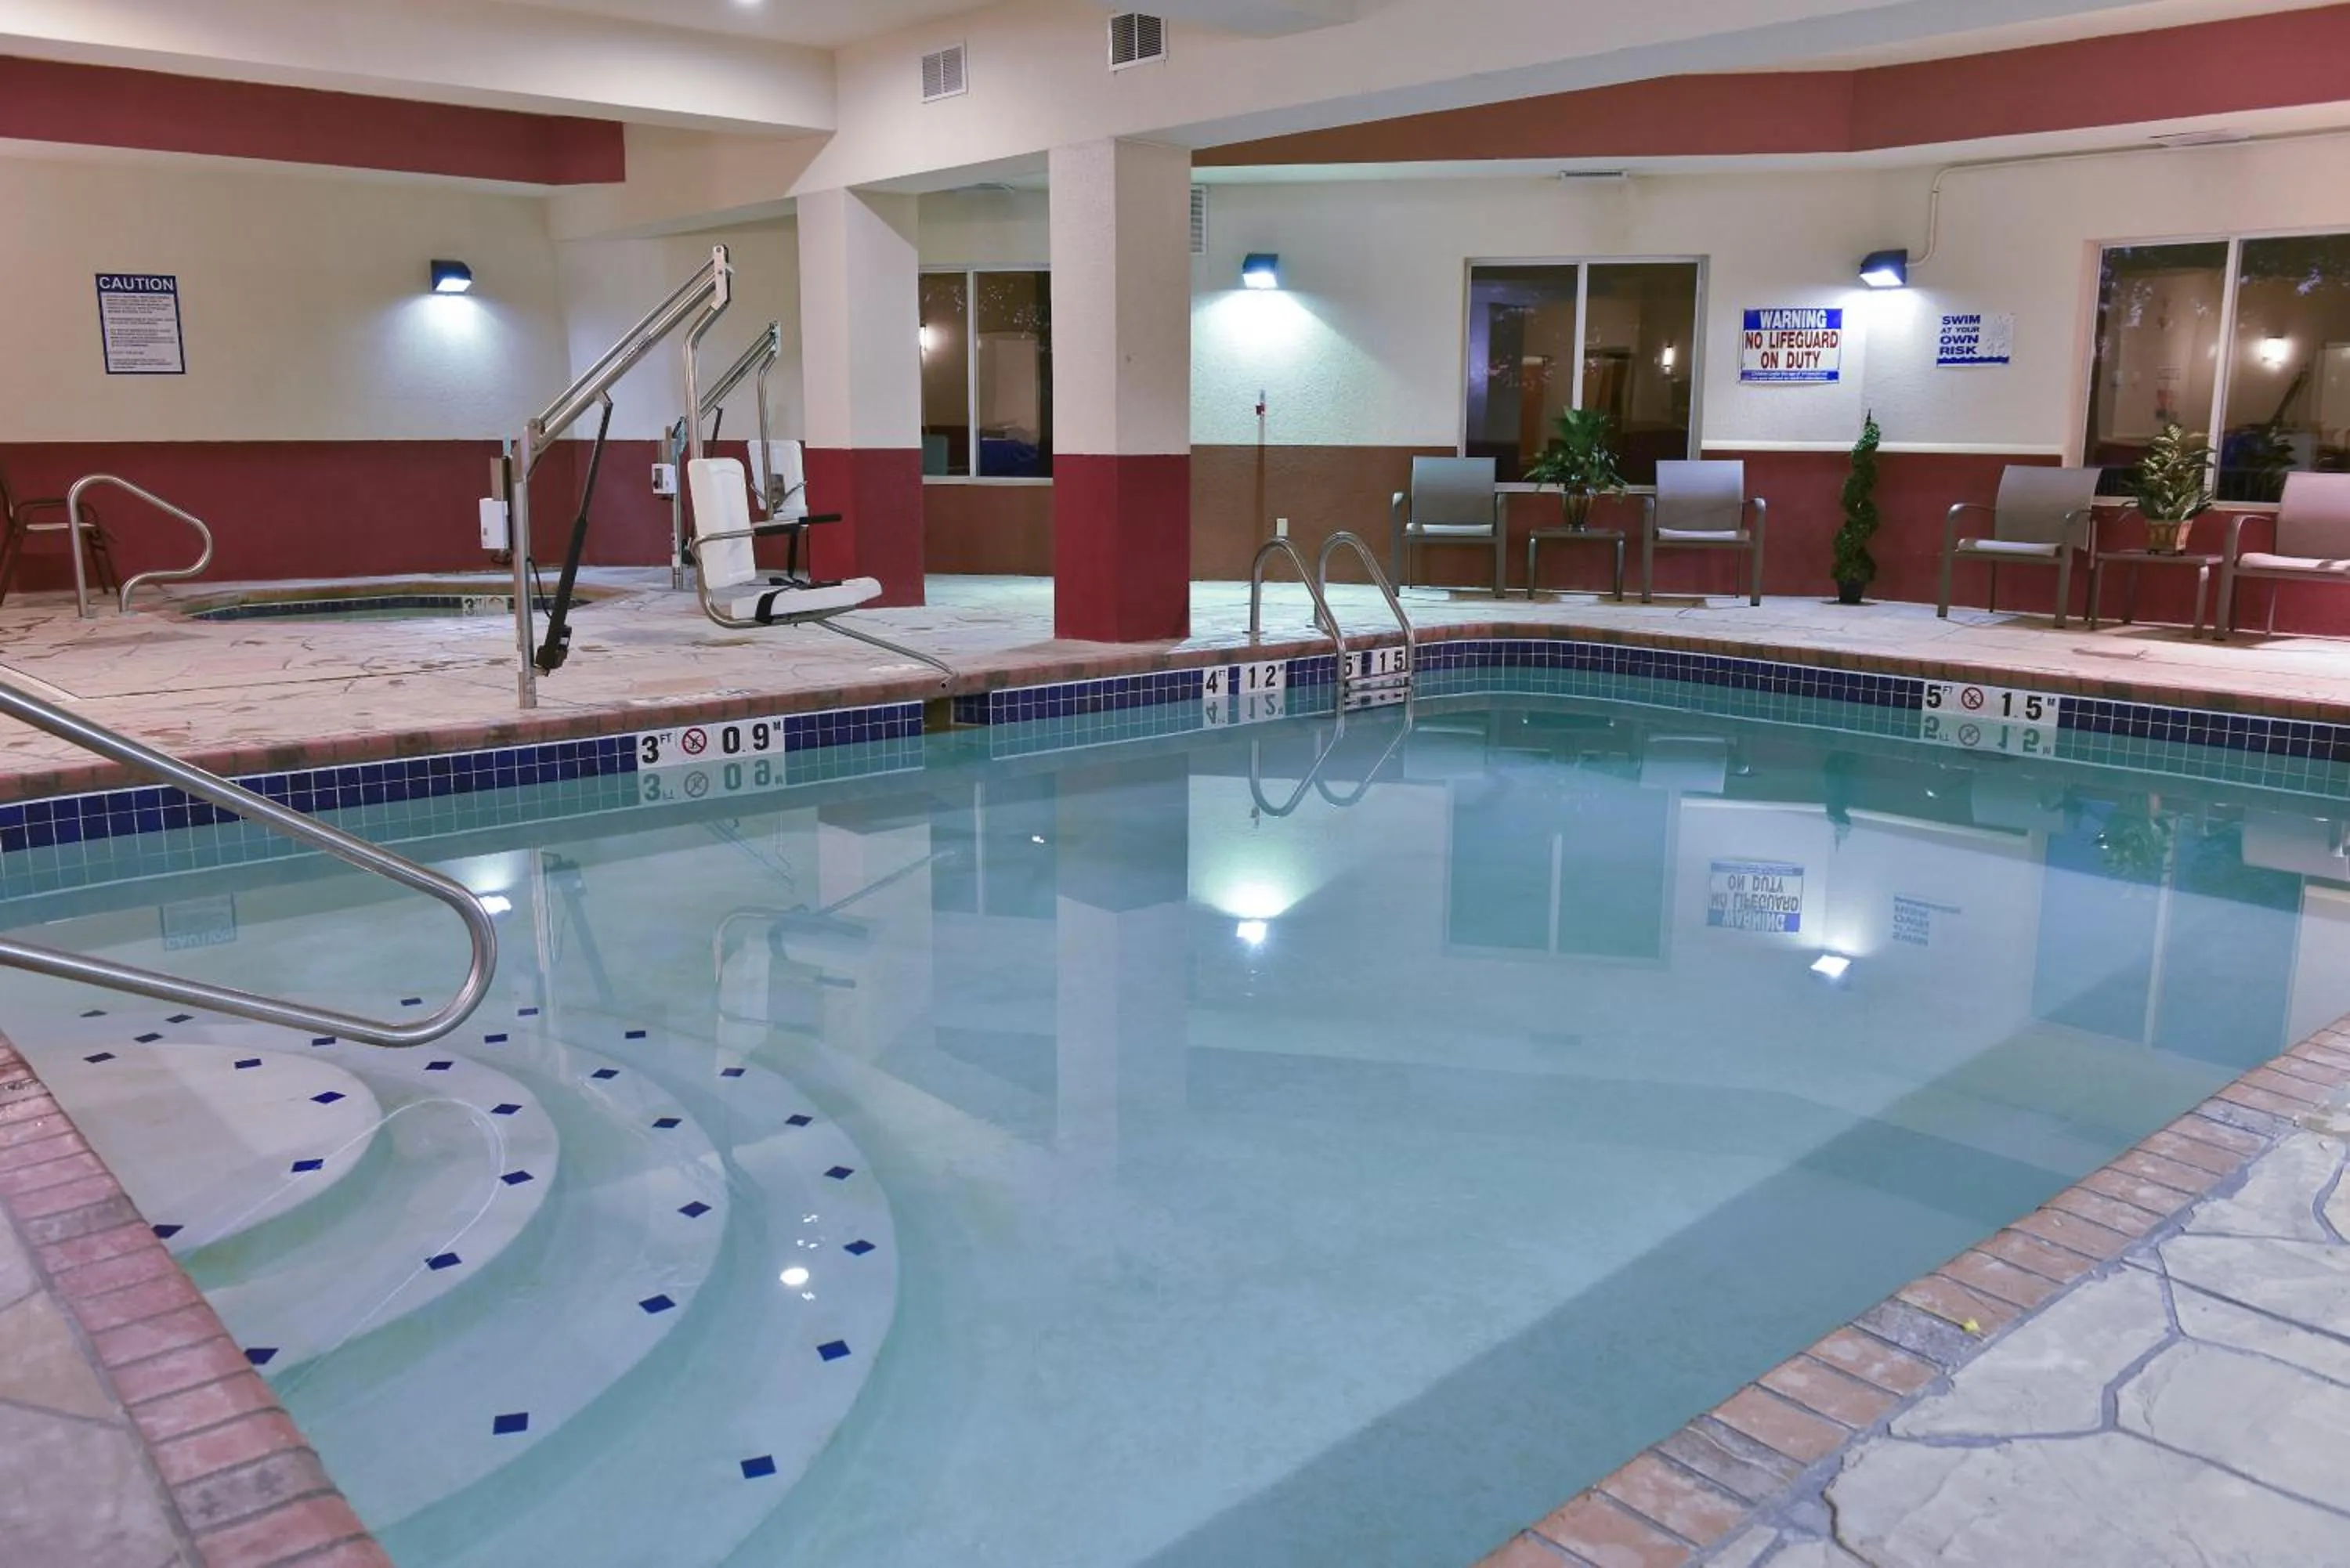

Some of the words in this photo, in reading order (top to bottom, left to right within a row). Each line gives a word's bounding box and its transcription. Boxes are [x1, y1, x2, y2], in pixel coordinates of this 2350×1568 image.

[99, 276, 174, 291] CAUTION
[1759, 310, 1827, 328] WARNING
[1942, 315, 1980, 325] SWIM
[1745, 331, 1762, 349] NO
[1769, 331, 1838, 349] LIFEGUARD
[1940, 334, 1979, 345] OWN
[1940, 345, 1976, 355] RISK
[1761, 351, 1778, 368] ON
[1787, 351, 1820, 368] DUTY
